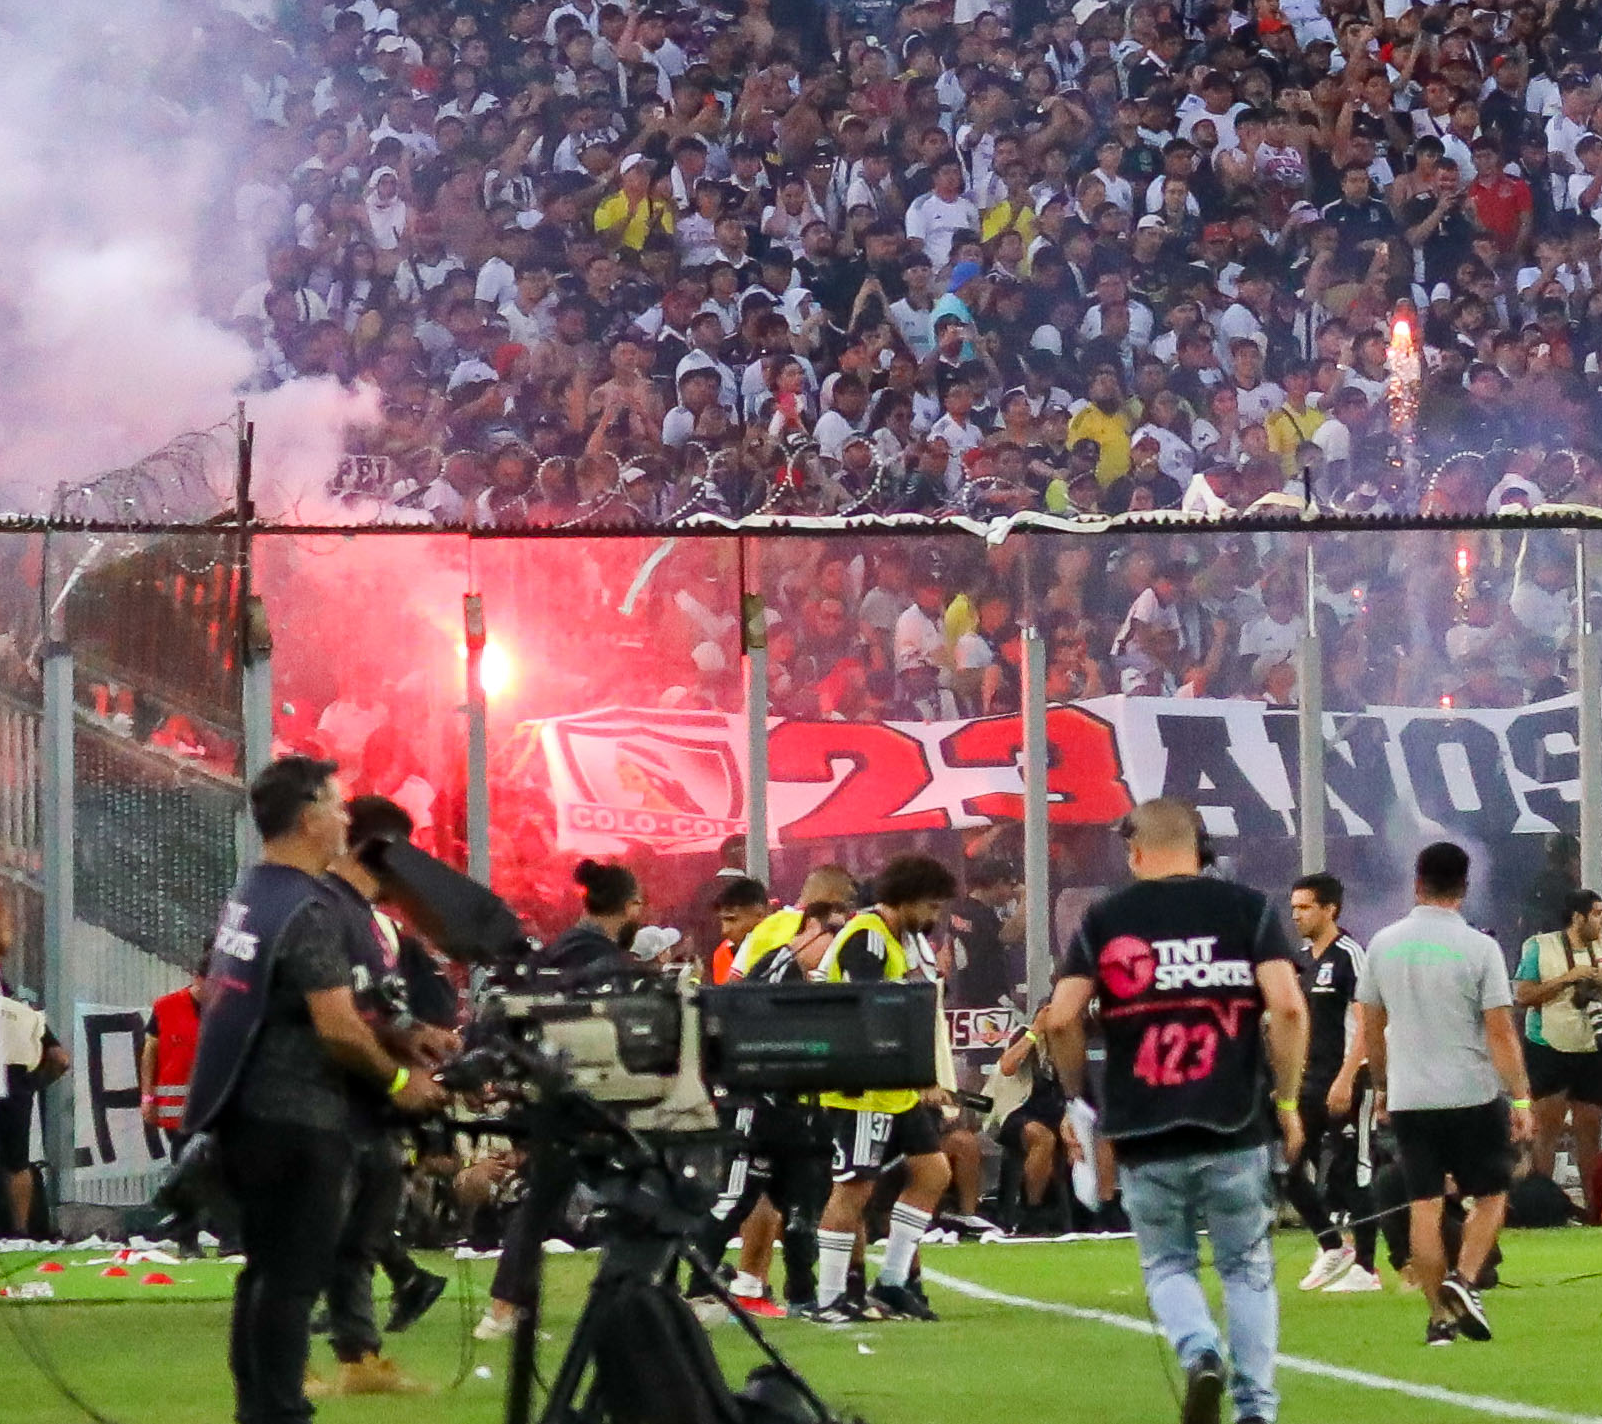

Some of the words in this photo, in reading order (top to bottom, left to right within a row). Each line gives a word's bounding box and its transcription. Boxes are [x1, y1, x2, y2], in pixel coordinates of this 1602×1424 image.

[766, 704, 1136, 841] 23
[1151, 936, 1218, 965] TNT
[1154, 959, 1255, 992] SPORTS
